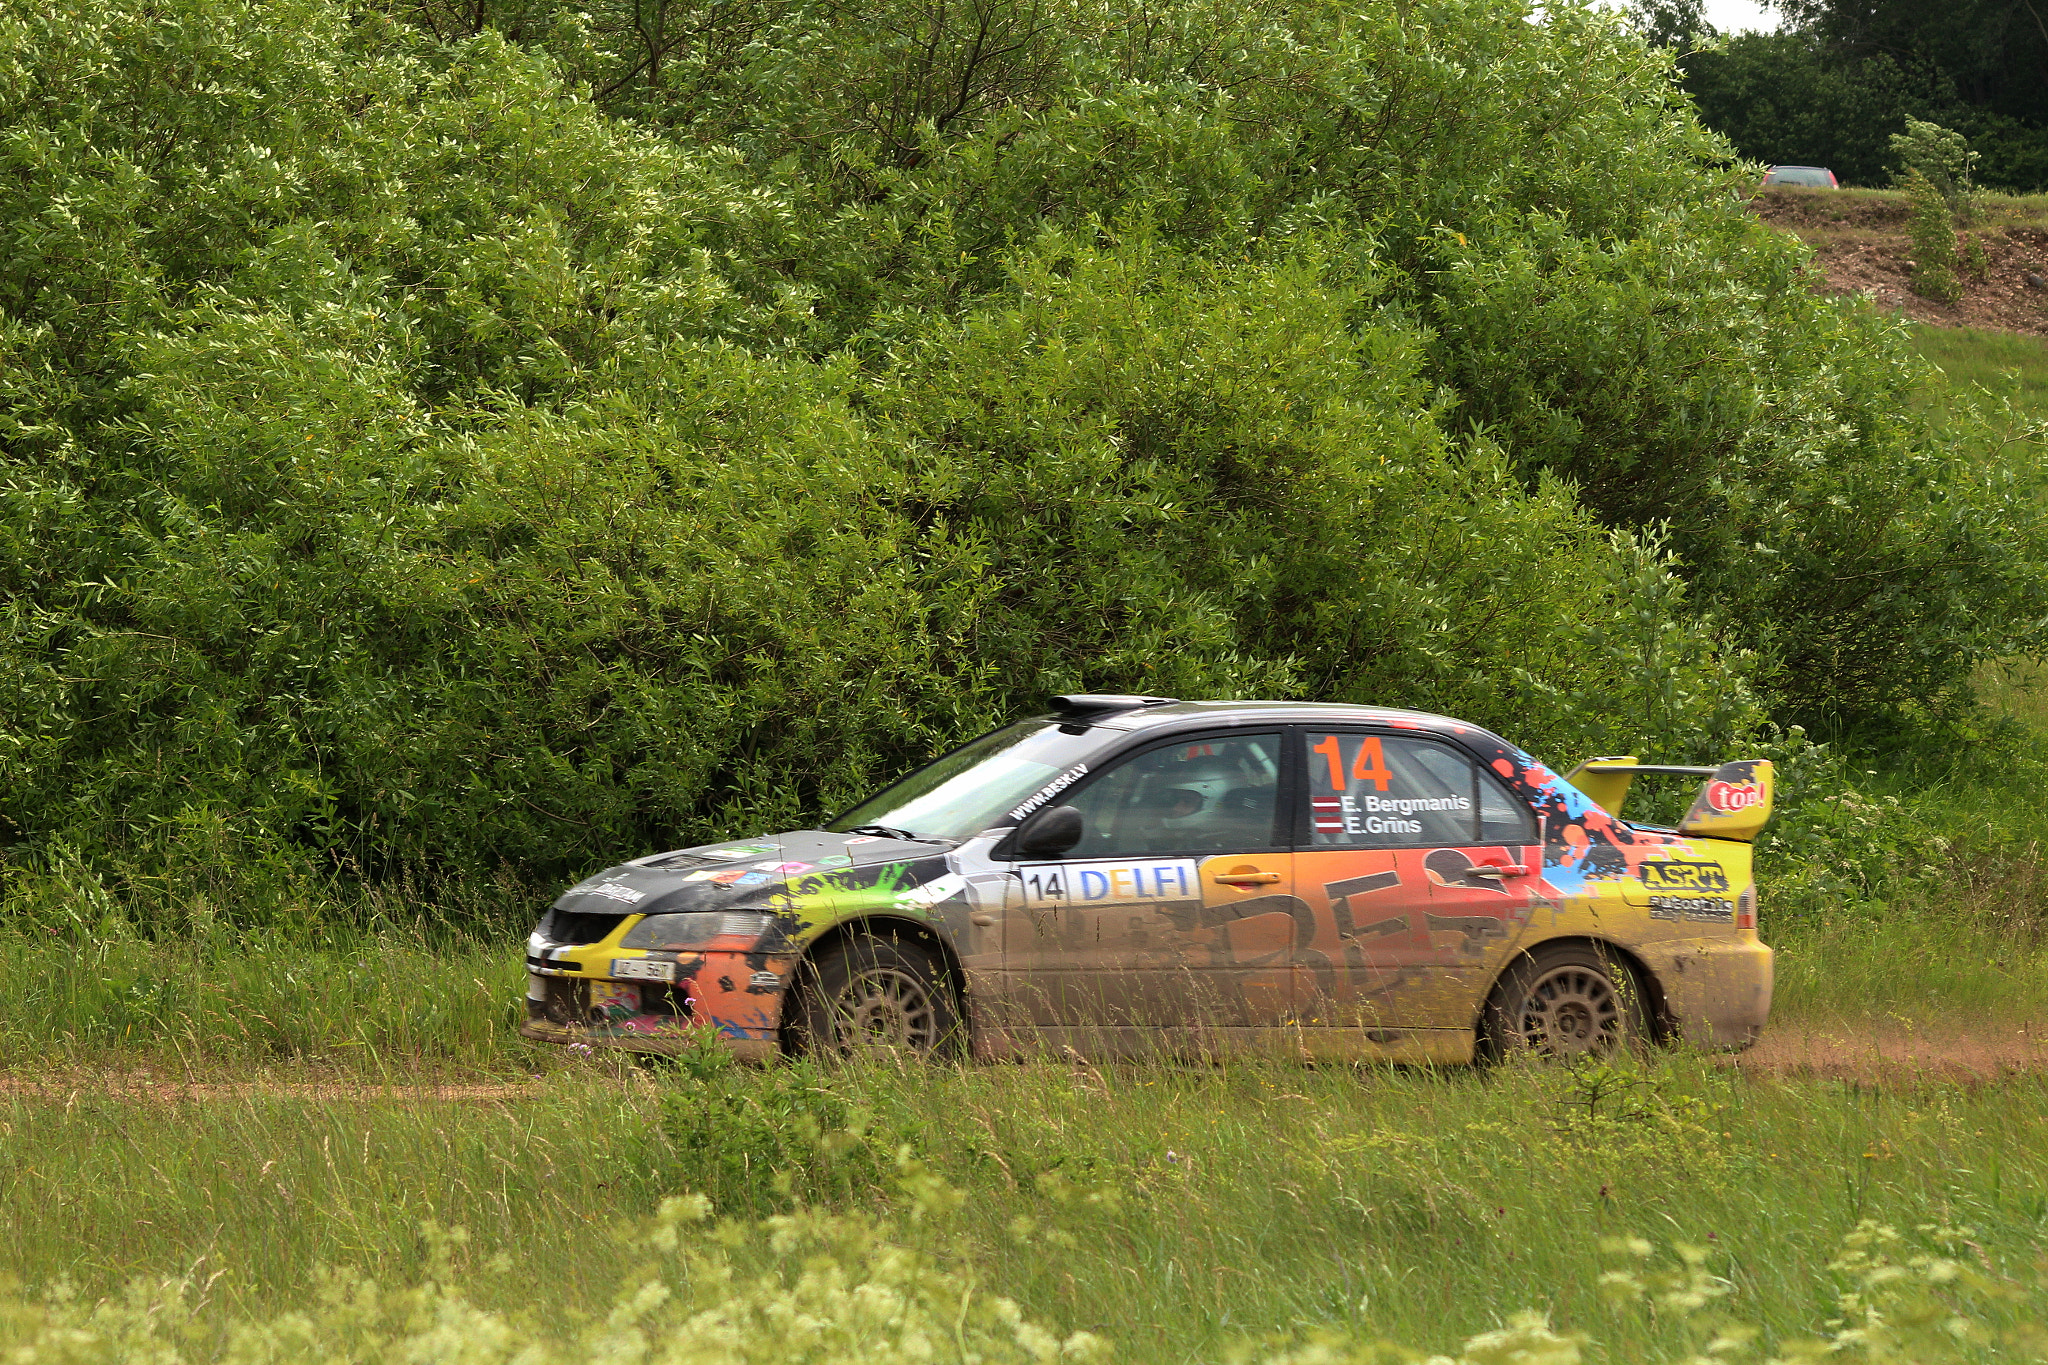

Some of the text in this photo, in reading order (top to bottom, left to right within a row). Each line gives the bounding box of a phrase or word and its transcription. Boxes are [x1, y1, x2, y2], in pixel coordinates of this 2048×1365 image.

[1313, 735, 1393, 792] 14
[1340, 795, 1471, 816] E. Bergmanis
[1028, 866, 1190, 902] 14 DELFI
[1643, 864, 1726, 890] ASRT
